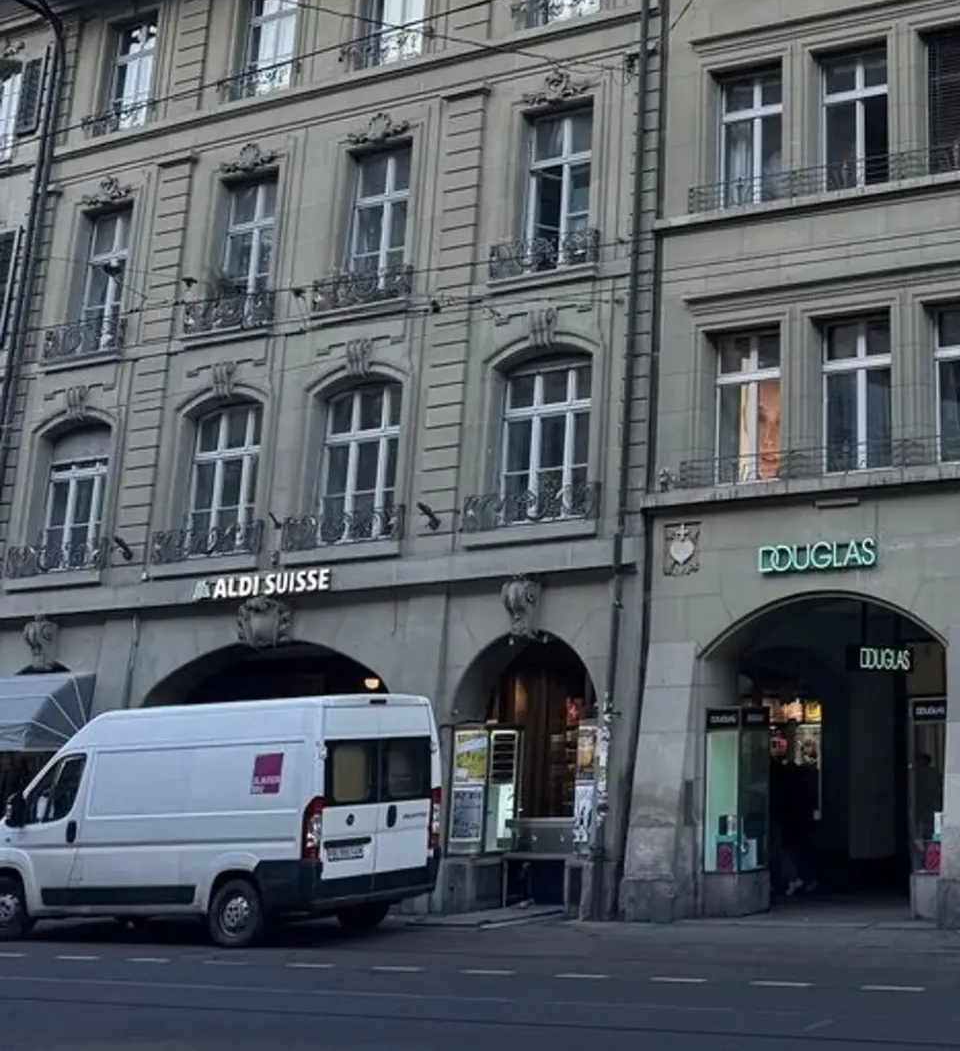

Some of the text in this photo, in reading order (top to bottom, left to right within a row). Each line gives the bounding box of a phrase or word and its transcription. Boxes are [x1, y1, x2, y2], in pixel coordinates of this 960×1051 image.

[757, 537, 876, 573] DOUGLAS
[212, 568, 330, 599] ALDI SUISSE
[860, 647, 911, 670] DOUGLAS
